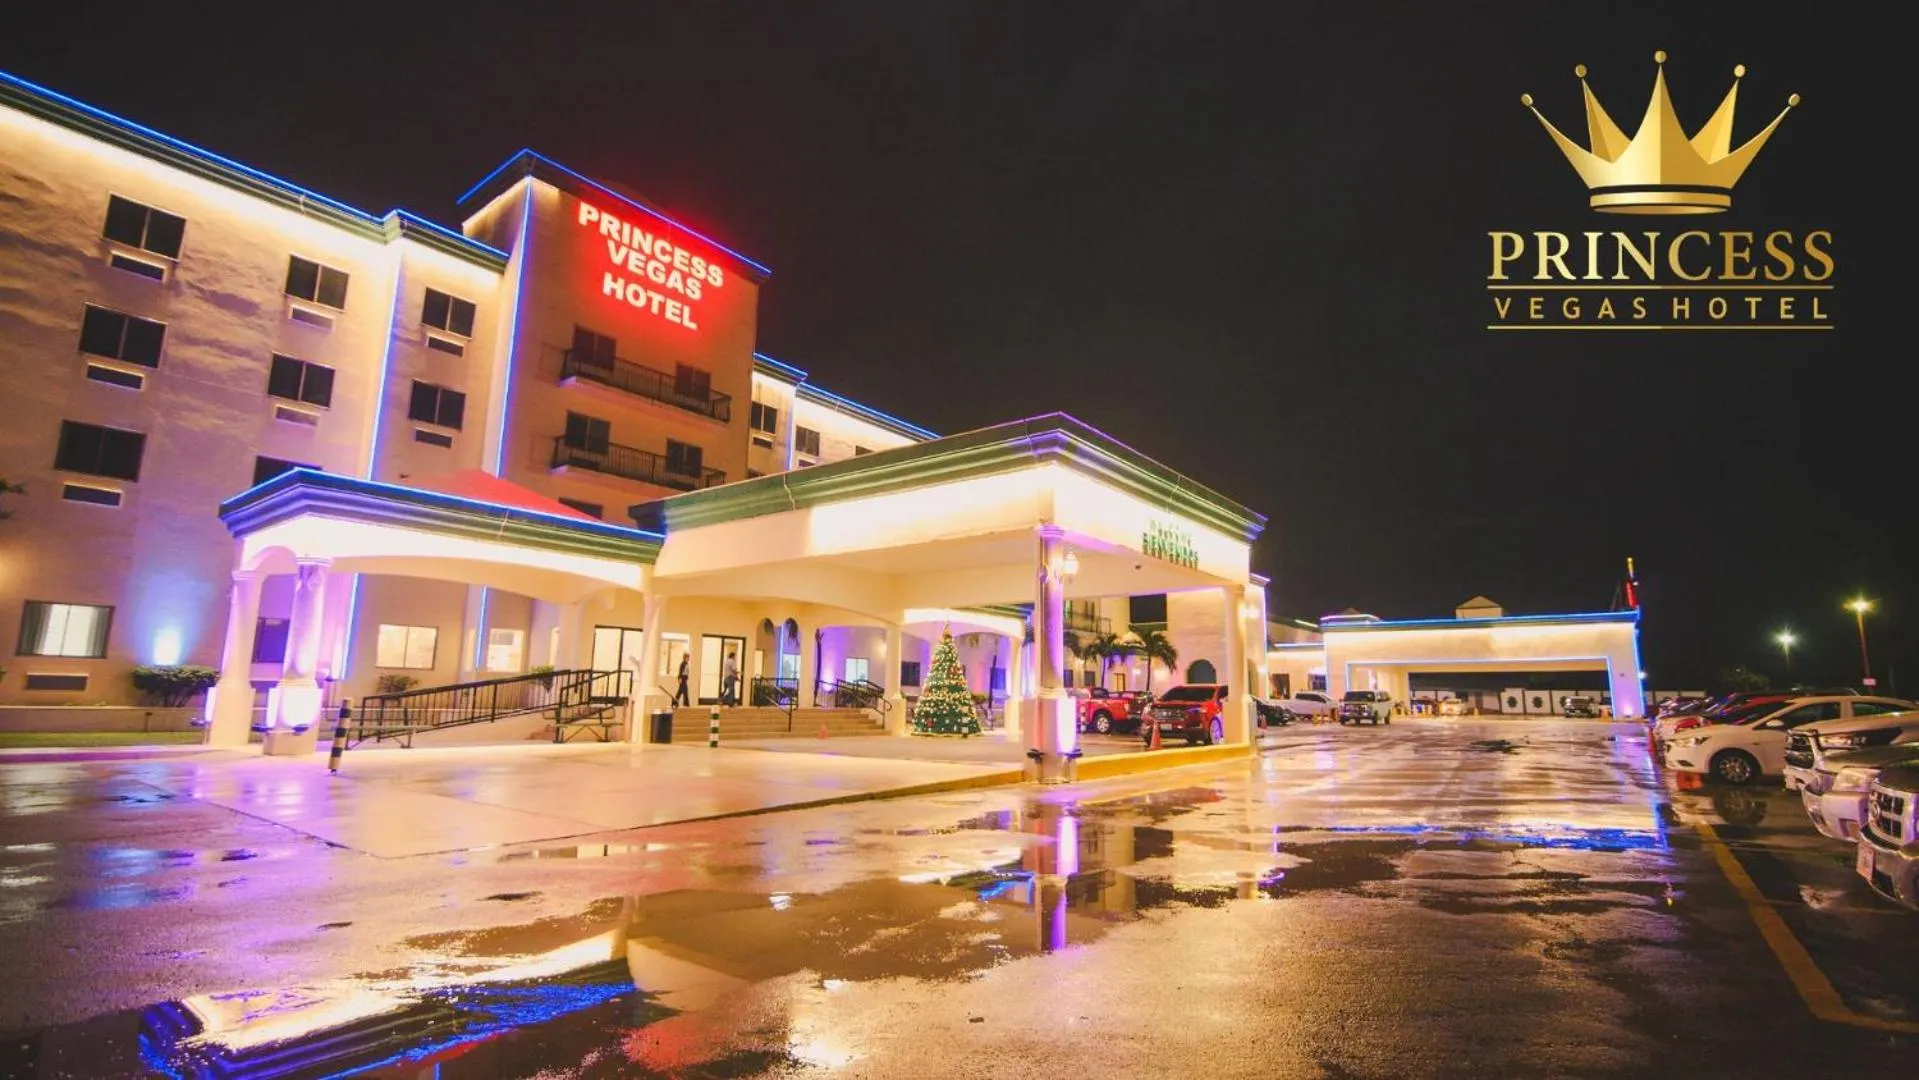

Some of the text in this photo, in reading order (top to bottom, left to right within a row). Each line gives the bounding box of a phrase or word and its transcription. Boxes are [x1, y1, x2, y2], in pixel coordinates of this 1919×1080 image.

[578, 201, 724, 288] PRINCESS
[607, 239, 702, 300] VEGAS
[603, 272, 698, 331] HOTEL
